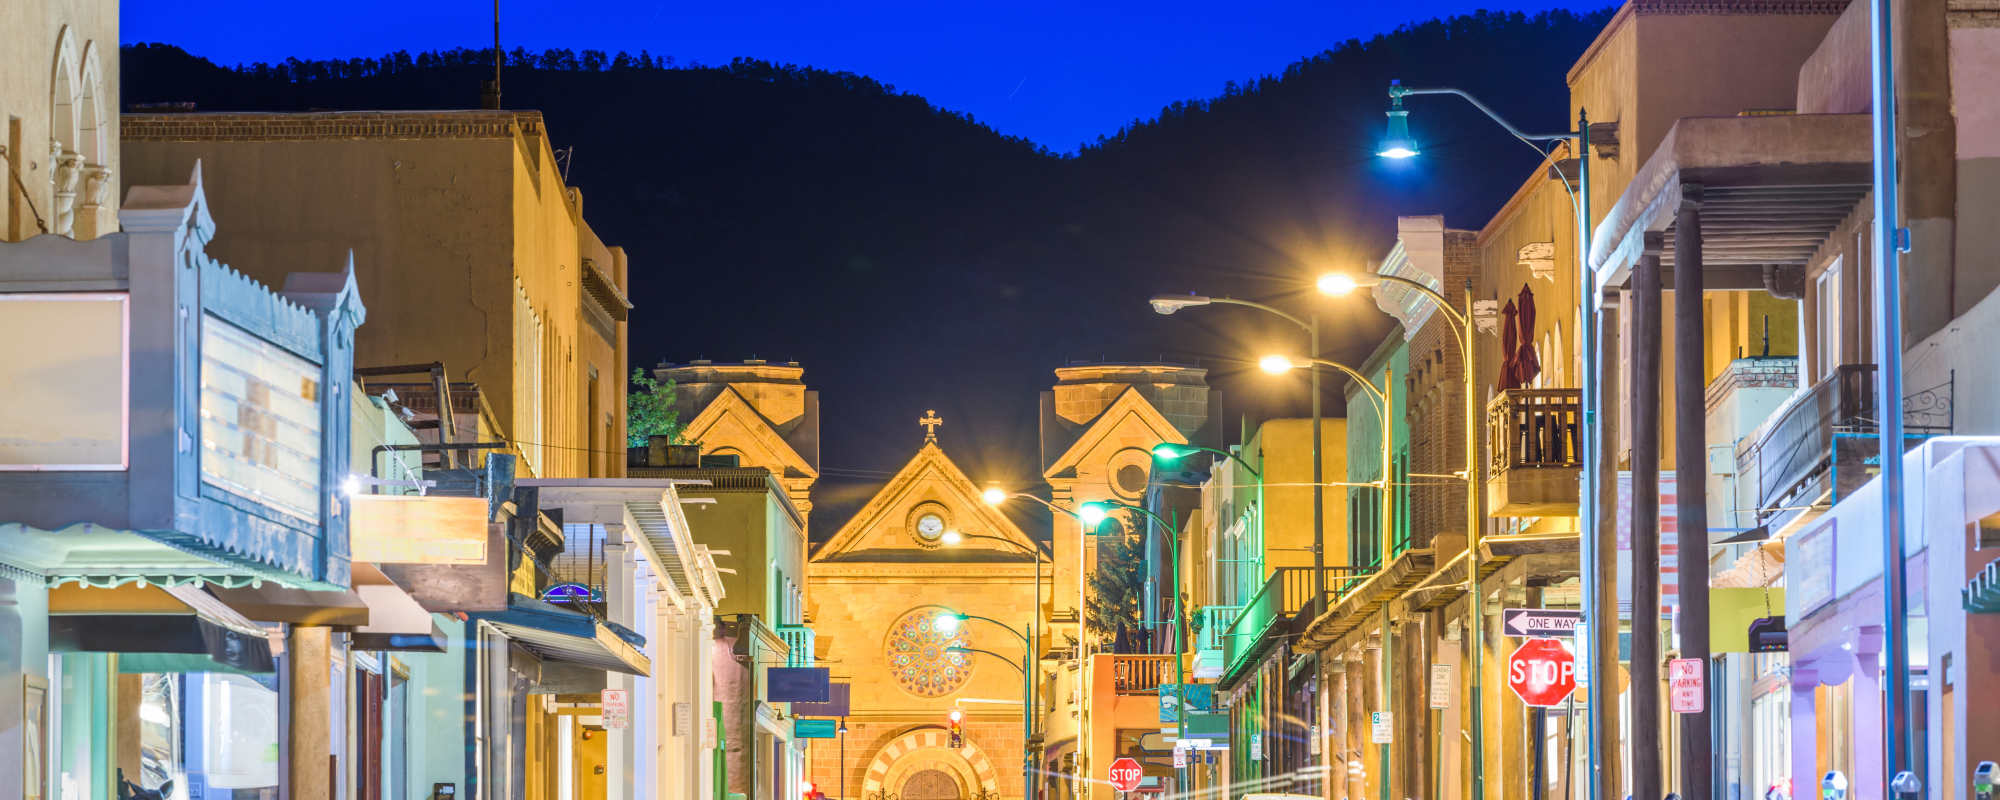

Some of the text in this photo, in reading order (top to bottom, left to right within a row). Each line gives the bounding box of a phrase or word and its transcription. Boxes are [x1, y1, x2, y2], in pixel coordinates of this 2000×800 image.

[1528, 618, 1576, 629] ONE WAY
[1511, 659, 1574, 686] STOP
[1681, 664, 1694, 675] NO
[1672, 679, 1702, 689] PARKING
[1111, 768, 1140, 782] STOP
